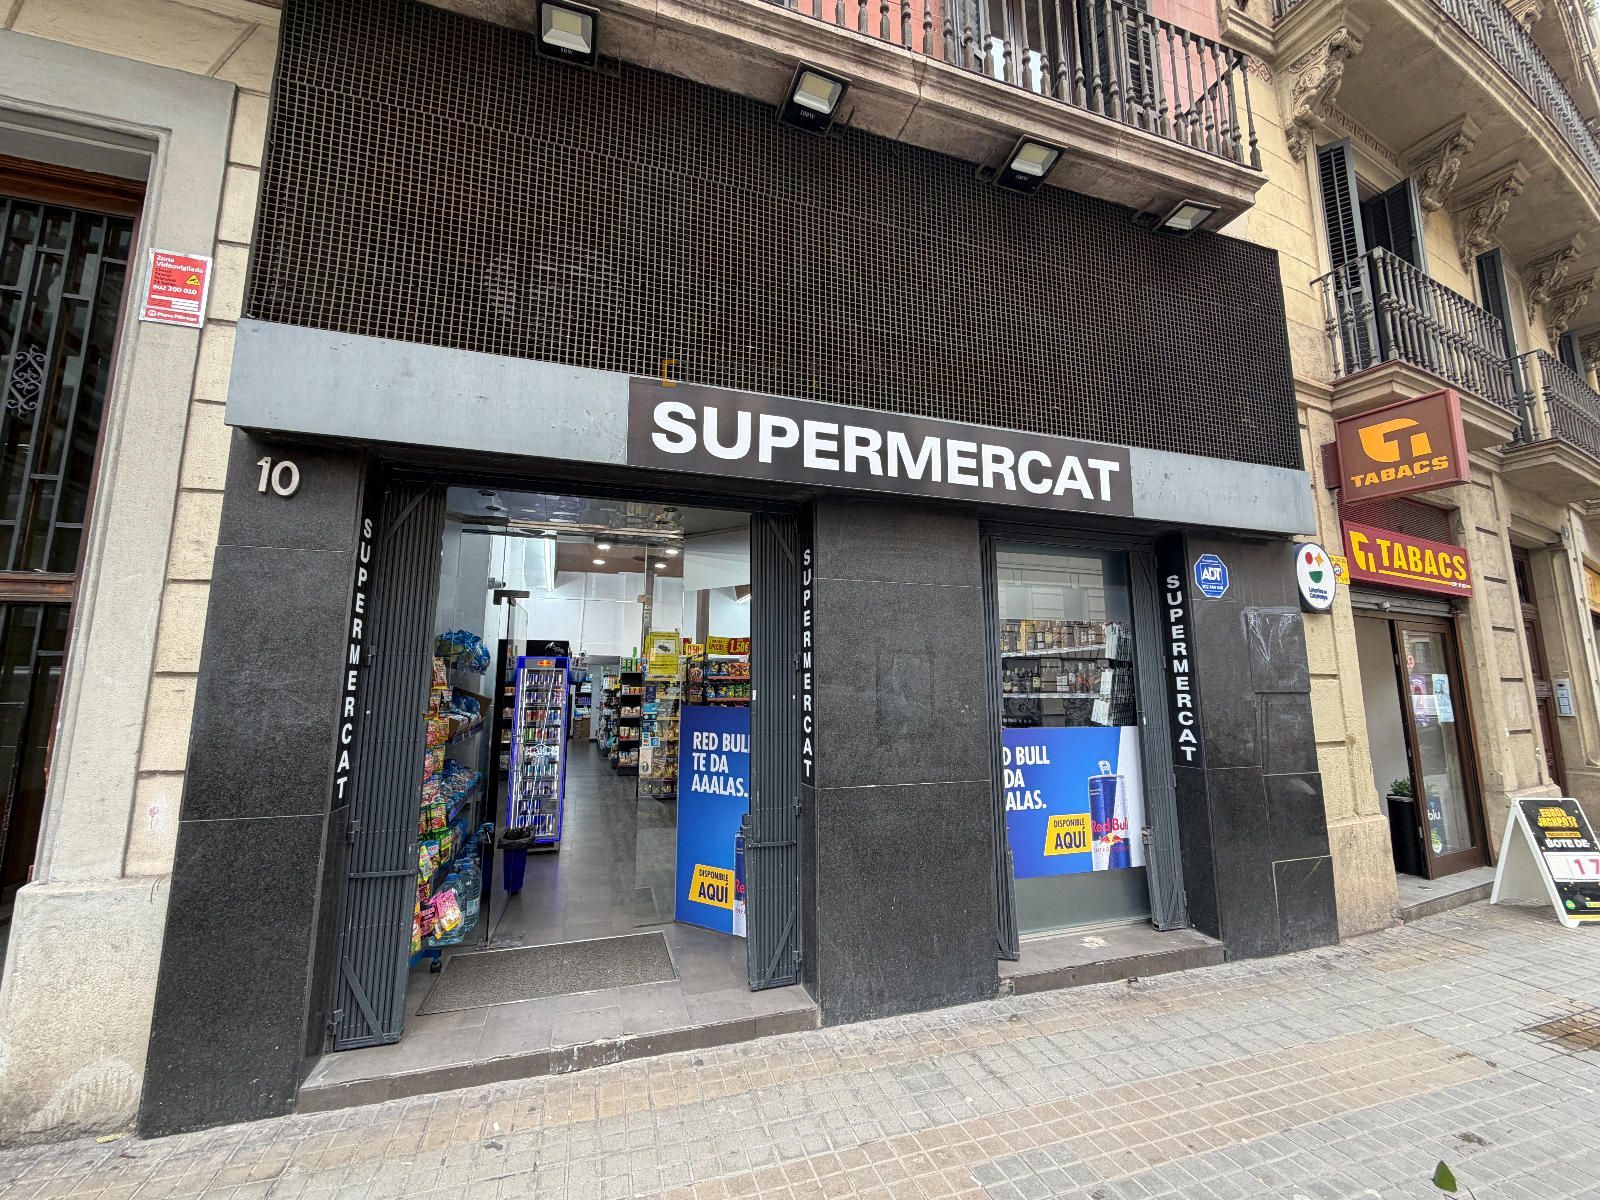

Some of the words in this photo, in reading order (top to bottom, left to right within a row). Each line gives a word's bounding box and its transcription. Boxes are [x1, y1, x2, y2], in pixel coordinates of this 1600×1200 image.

[156, 254, 175, 263] Zona
[168, 285, 182, 293] 200
[651, 401, 1120, 502] SUPERMERCAT
[257, 456, 300, 496] 10
[1351, 455, 1449, 488] TABACS
[1376, 538, 1467, 581] TABACS
[1201, 566, 1222, 581] ADT
[337, 518, 373, 799] SUPERMERCAT
[803, 549, 813, 777] SUPERMERCAT
[1166, 575, 1198, 761] SUPERMERCAT
[693, 731, 719, 750] RED
[692, 752, 707, 771] TE
[710, 753, 729, 773] DA
[1003, 746, 1012, 766] D
[1015, 745, 1050, 766] BULL
[691, 773, 749, 798] AAALAS.
[1004, 769, 1025, 789] DA
[1006, 789, 1047, 812] ALAS.
[1053, 818, 1085, 828] DISPONIBLE
[1091, 817, 1111, 833] Red
[1427, 809, 1441, 821] blu
[1055, 827, 1086, 850] AQUÍ
[1545, 838, 1575, 848] BOTE
[1574, 839, 1590, 848] DE
[699, 869, 729, 882] DISPONIBLE
[698, 882, 729, 904] AQUÍ
[734, 879, 745, 894] Re
